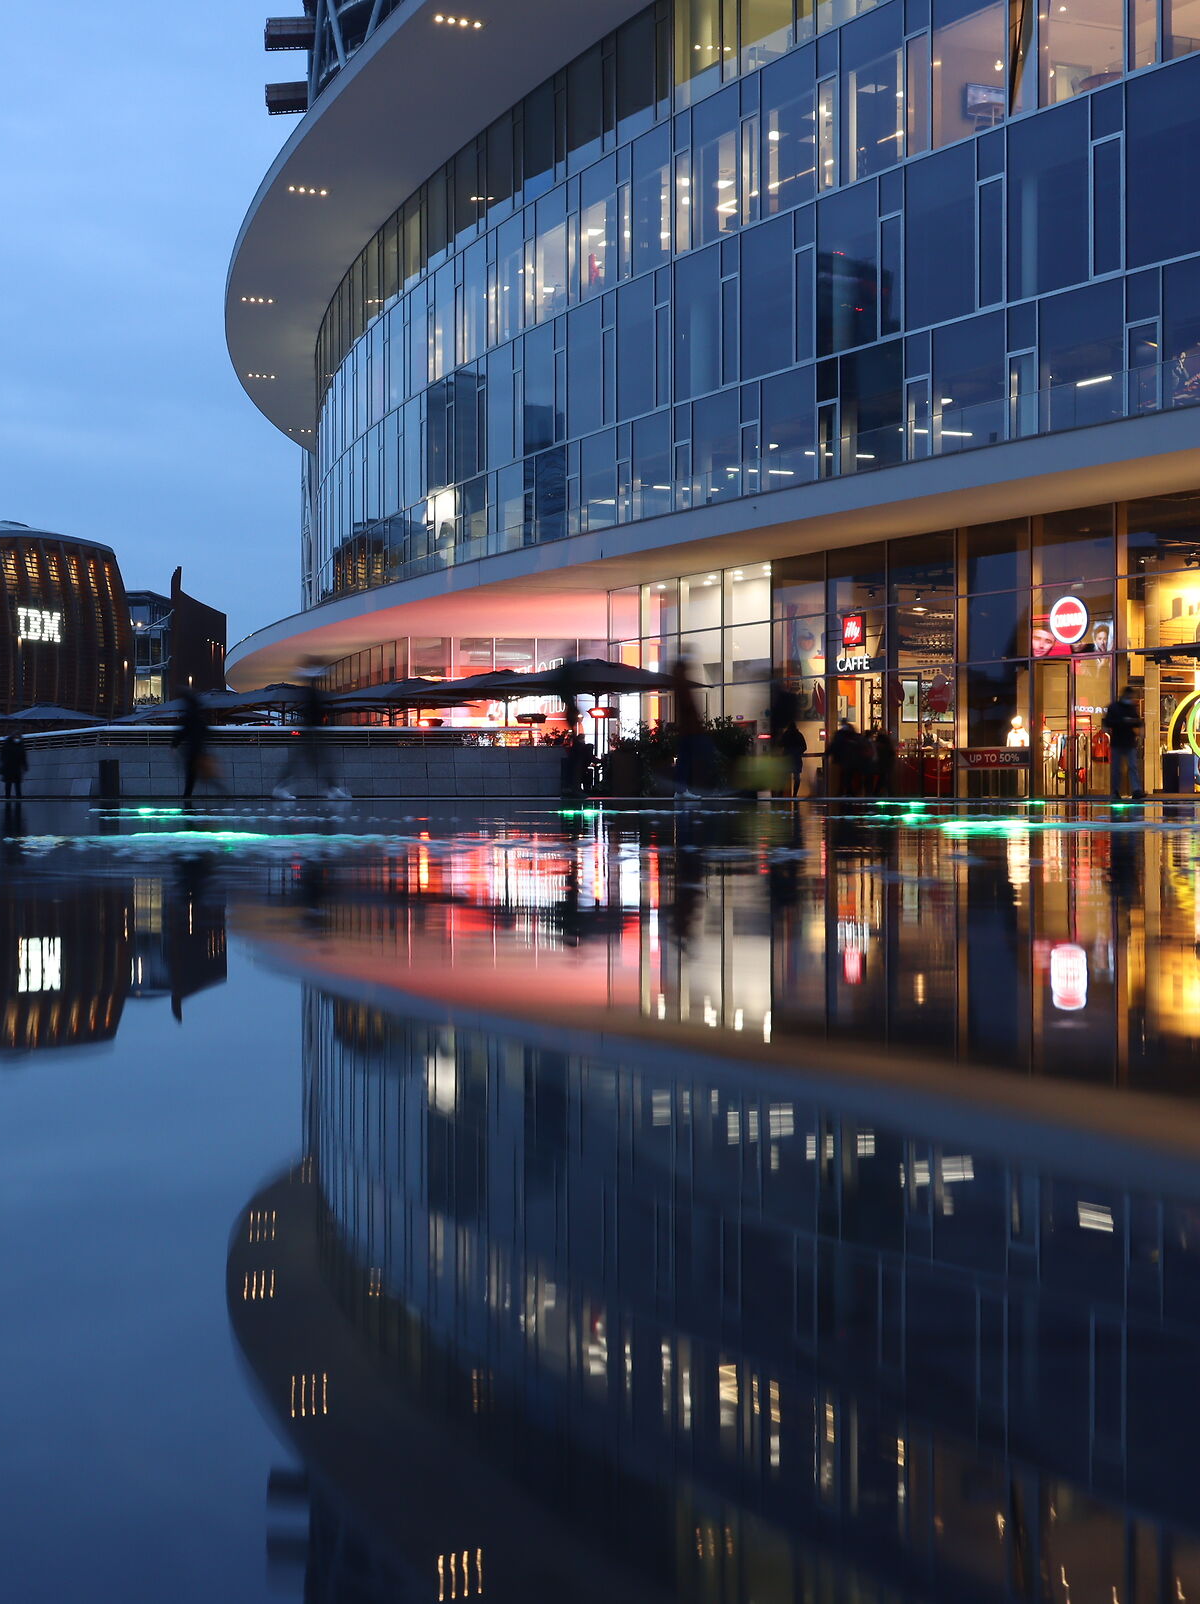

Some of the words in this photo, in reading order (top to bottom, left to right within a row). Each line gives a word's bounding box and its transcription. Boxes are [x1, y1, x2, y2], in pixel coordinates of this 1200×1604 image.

[17, 607, 61, 642] IBM
[845, 621, 860, 641] illy
[969, 754, 982, 763] UP
[984, 753, 997, 763] TO
[999, 753, 1020, 763] 50%
